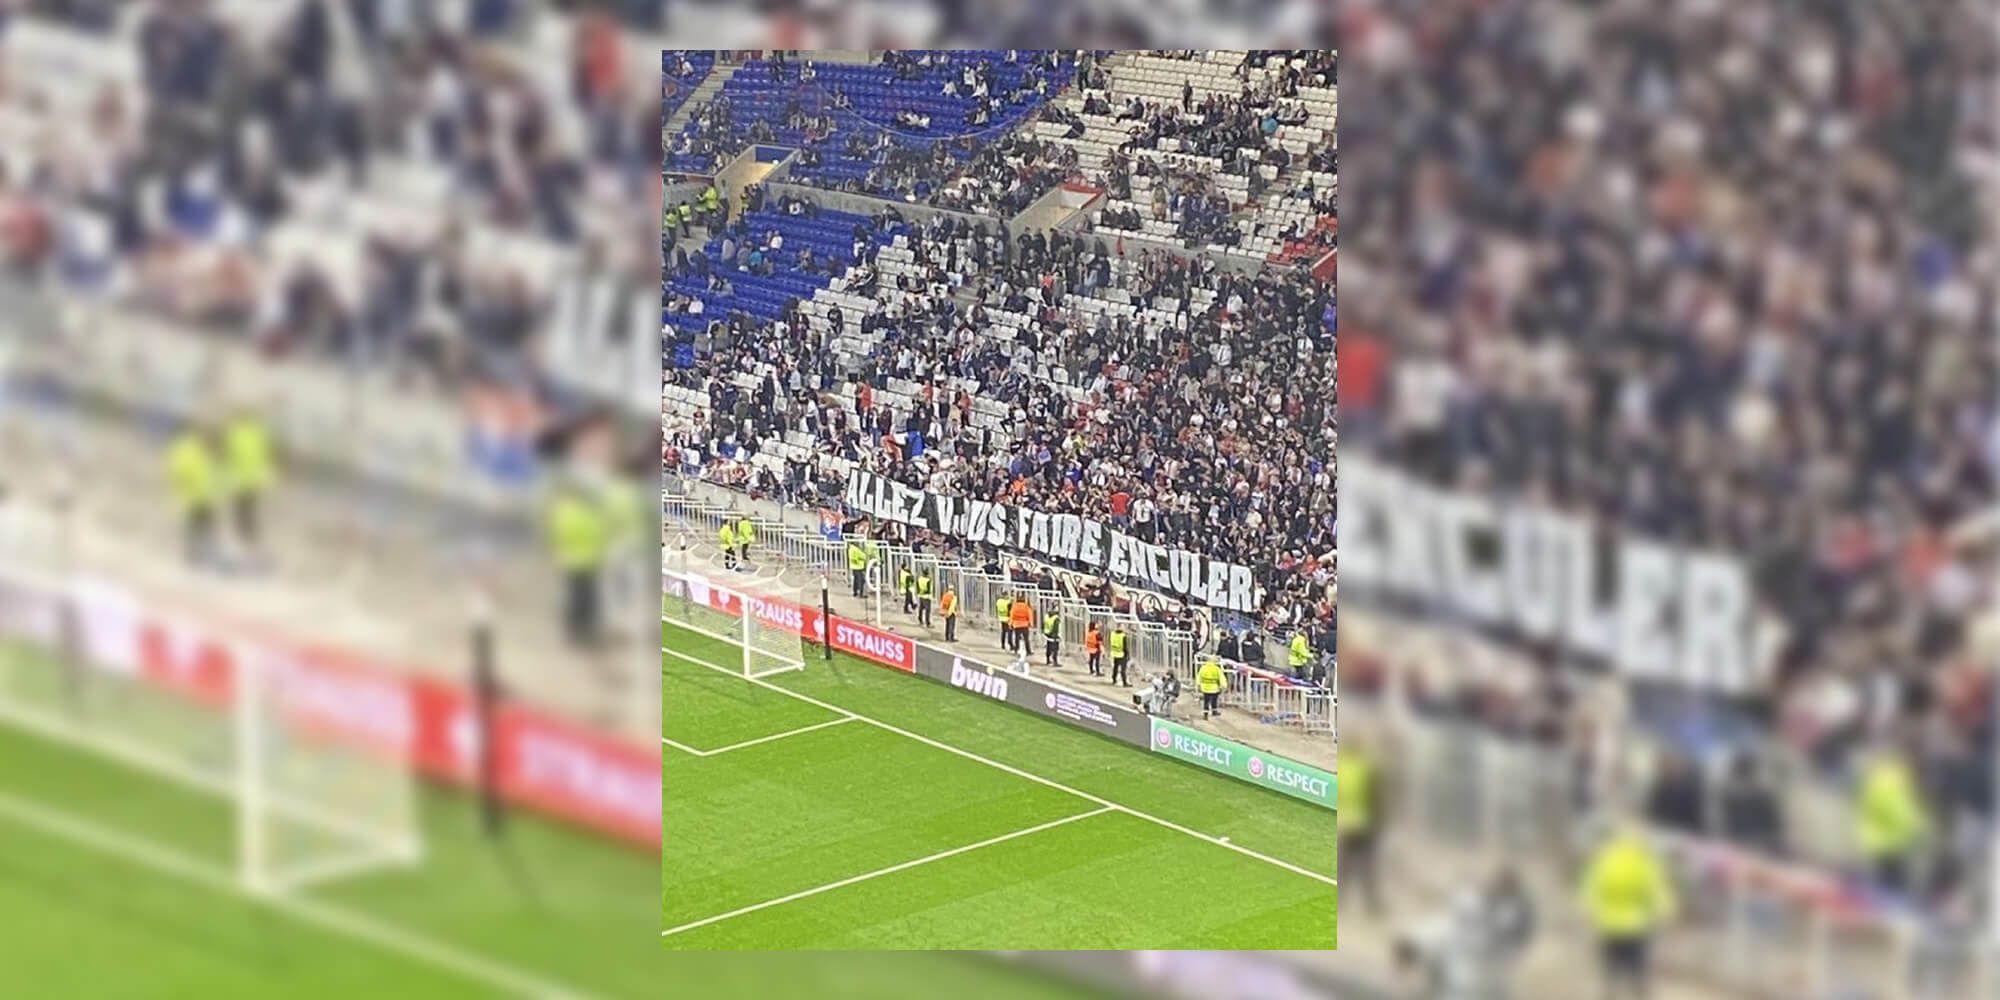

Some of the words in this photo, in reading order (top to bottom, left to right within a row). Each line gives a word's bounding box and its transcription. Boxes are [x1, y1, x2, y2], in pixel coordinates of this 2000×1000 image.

[846, 469, 927, 528] ALLEZ
[1018, 506, 1102, 566] FAIRE
[1109, 529, 1253, 612] ENCULER
[836, 624, 905, 663] STRAUSS
[951, 656, 1008, 701] bwin
[1174, 734, 1233, 767] RESPECT
[1266, 763, 1329, 798] RESPECT
